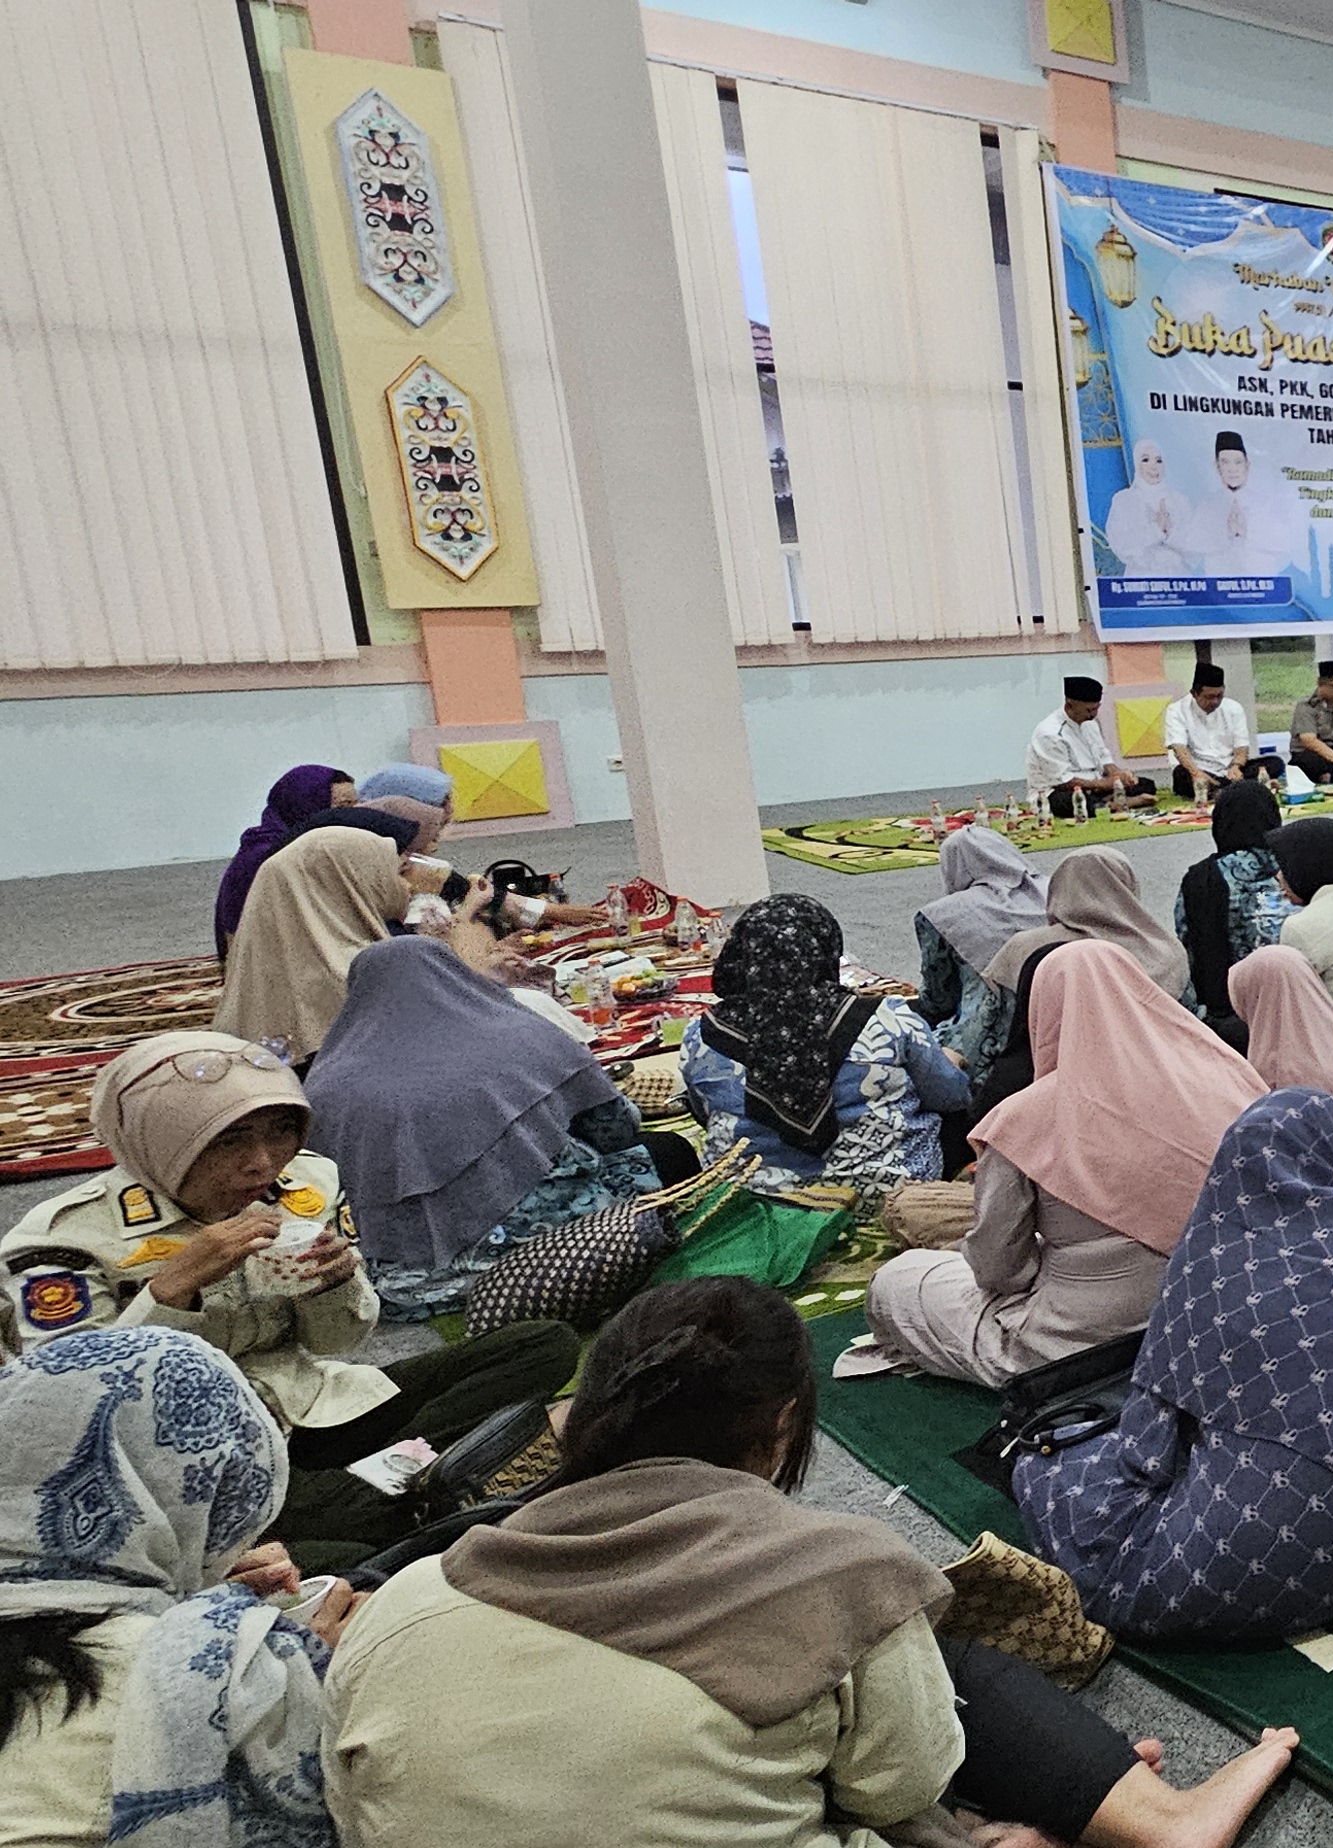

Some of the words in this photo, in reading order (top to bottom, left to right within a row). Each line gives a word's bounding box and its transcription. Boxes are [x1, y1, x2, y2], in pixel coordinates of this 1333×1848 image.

[1148, 296, 1258, 358] Buka
[1237, 375, 1274, 397] ASN,
[1279, 379, 1314, 399] PKK,
[1150, 392, 1167, 411] DI
[1173, 394, 1275, 417] LINGKUNGAN
